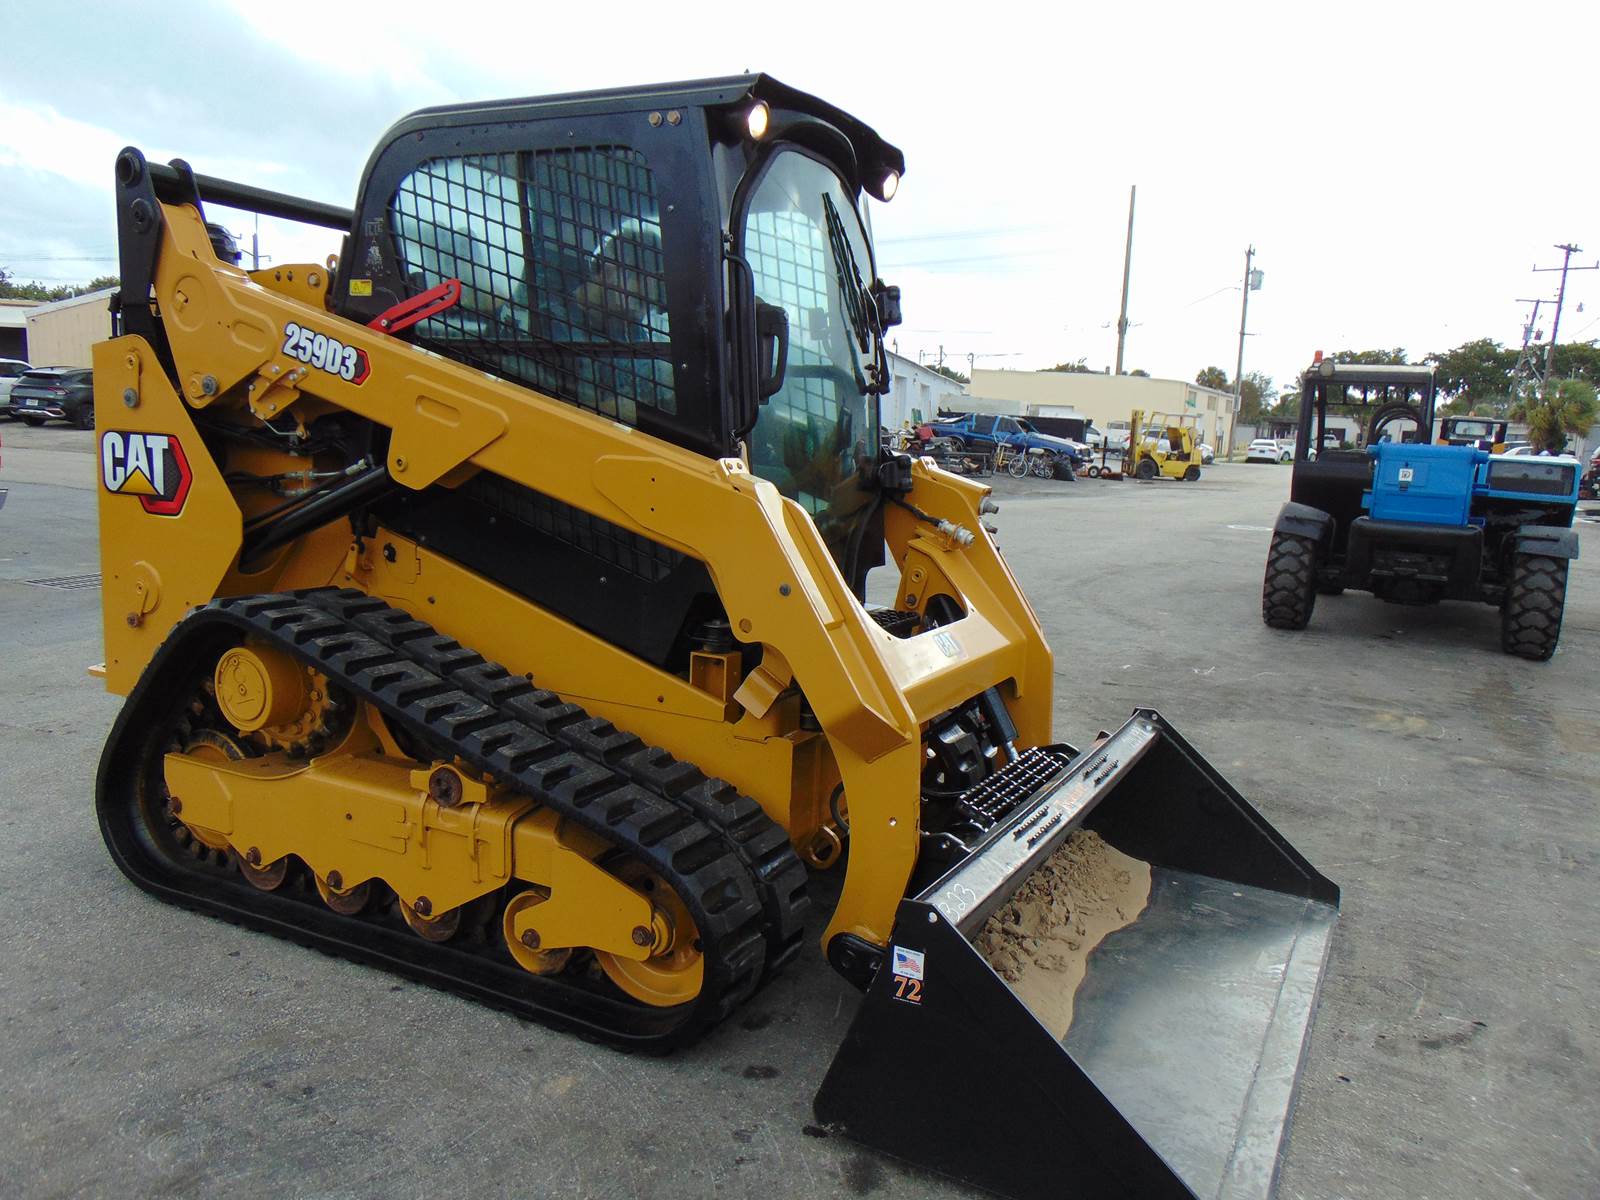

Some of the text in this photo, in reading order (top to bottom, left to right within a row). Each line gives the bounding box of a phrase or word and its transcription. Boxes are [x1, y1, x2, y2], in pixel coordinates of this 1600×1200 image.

[283, 322, 359, 381] 259D3
[102, 431, 169, 496] CAT
[894, 975, 922, 1002] 72
